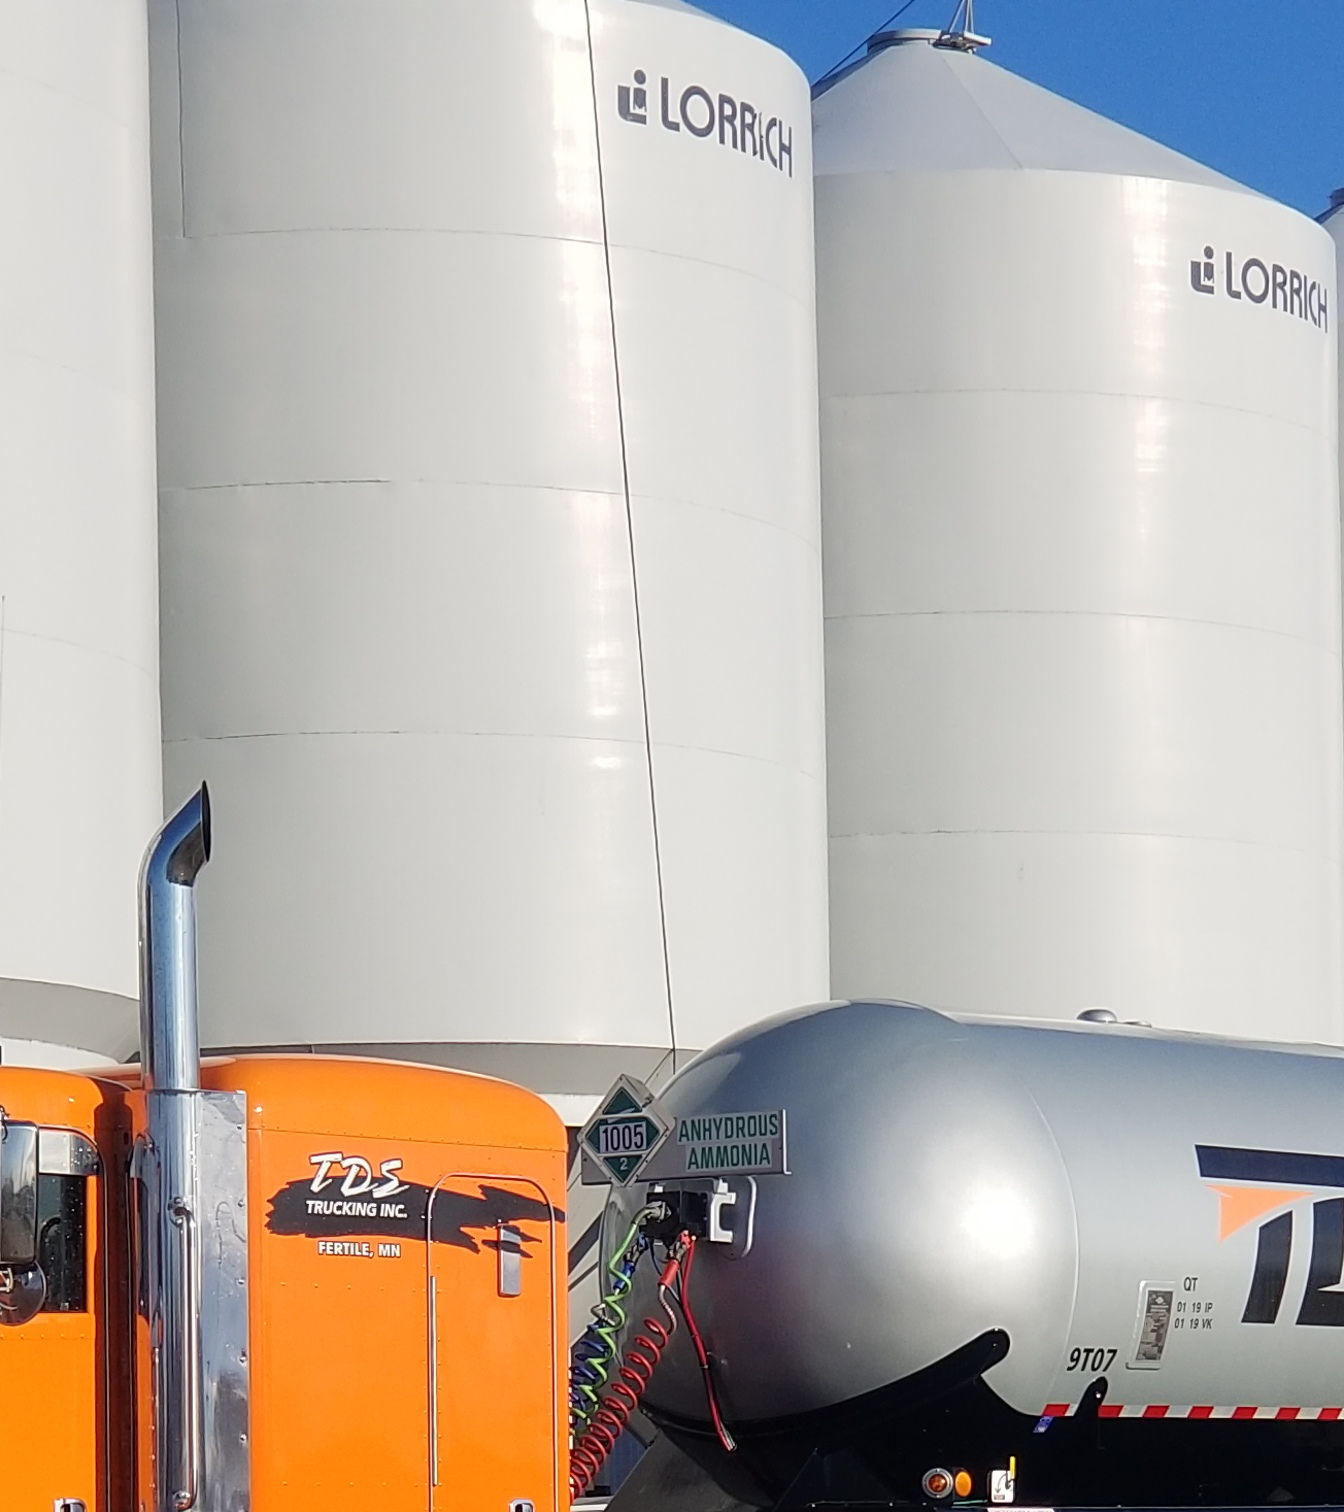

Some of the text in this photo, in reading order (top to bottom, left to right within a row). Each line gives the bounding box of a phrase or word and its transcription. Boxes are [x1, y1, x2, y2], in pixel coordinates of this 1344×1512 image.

[661, 76, 792, 178] LORRICH
[1226, 251, 1328, 333] LORRICH
[602, 1122, 644, 1151] 1005
[678, 1113, 778, 1142] ANHYDROUS
[620, 1157, 628, 1170] 2
[687, 1143, 771, 1170] AMMONIA
[308, 1152, 409, 1199] TDS
[306, 1200, 408, 1218] TRUCKING INC.
[317, 1241, 401, 1258] FERTILE, MN
[1183, 1276, 1198, 1291] QT
[1177, 1302, 1186, 1312] 01
[1192, 1302, 1201, 1313] 19
[1174, 1318, 1213, 1329] 01 19 VK
[1067, 1347, 1118, 1372] 9T07
